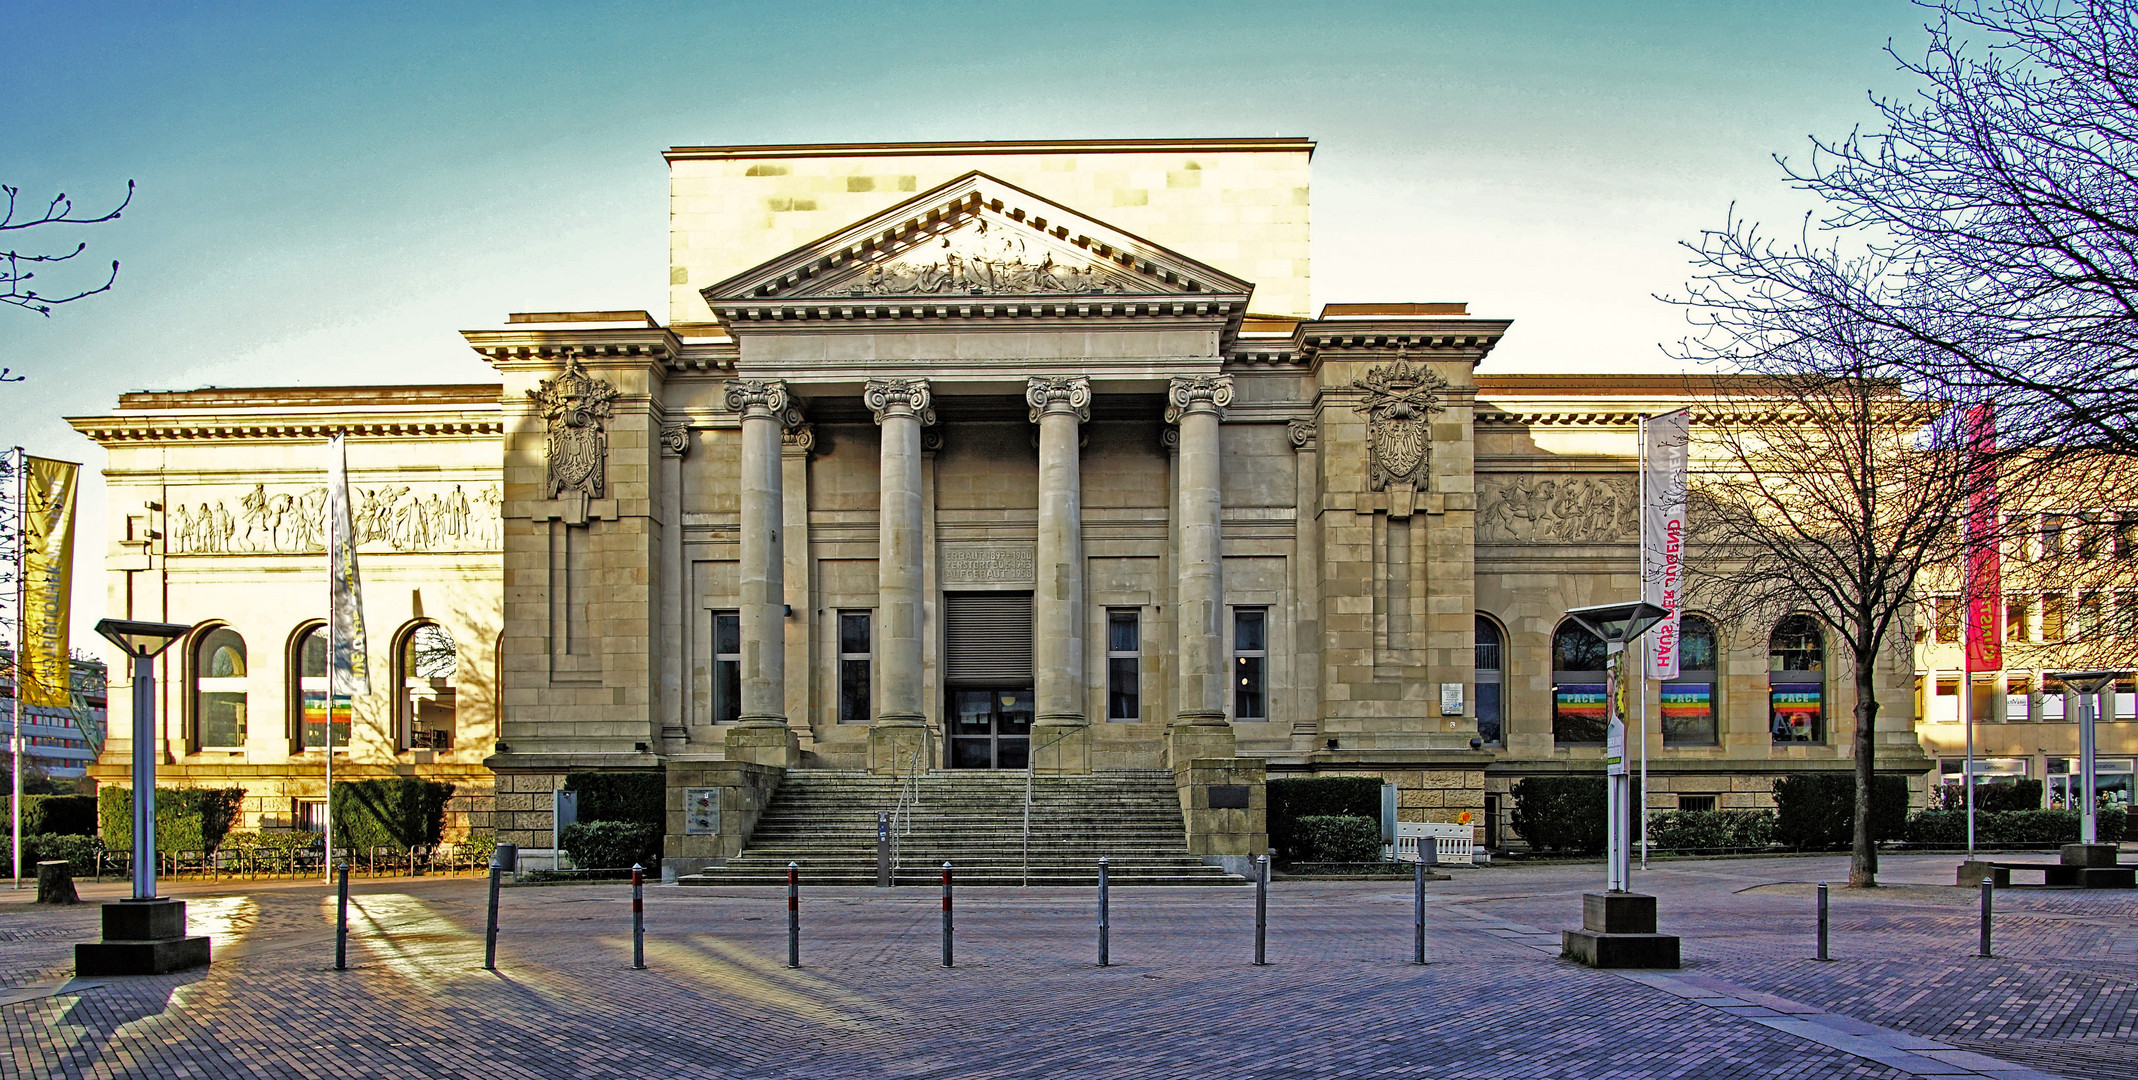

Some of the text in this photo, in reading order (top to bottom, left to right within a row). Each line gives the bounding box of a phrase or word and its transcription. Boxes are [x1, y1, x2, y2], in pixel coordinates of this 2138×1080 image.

[945, 552, 984, 560] ERBAUT
[945, 570, 1008, 578] AUFGEBAUT
[1567, 694, 1595, 703] PACE
[1670, 693, 1698, 703] PACE
[1781, 693, 1809, 703] PACE
